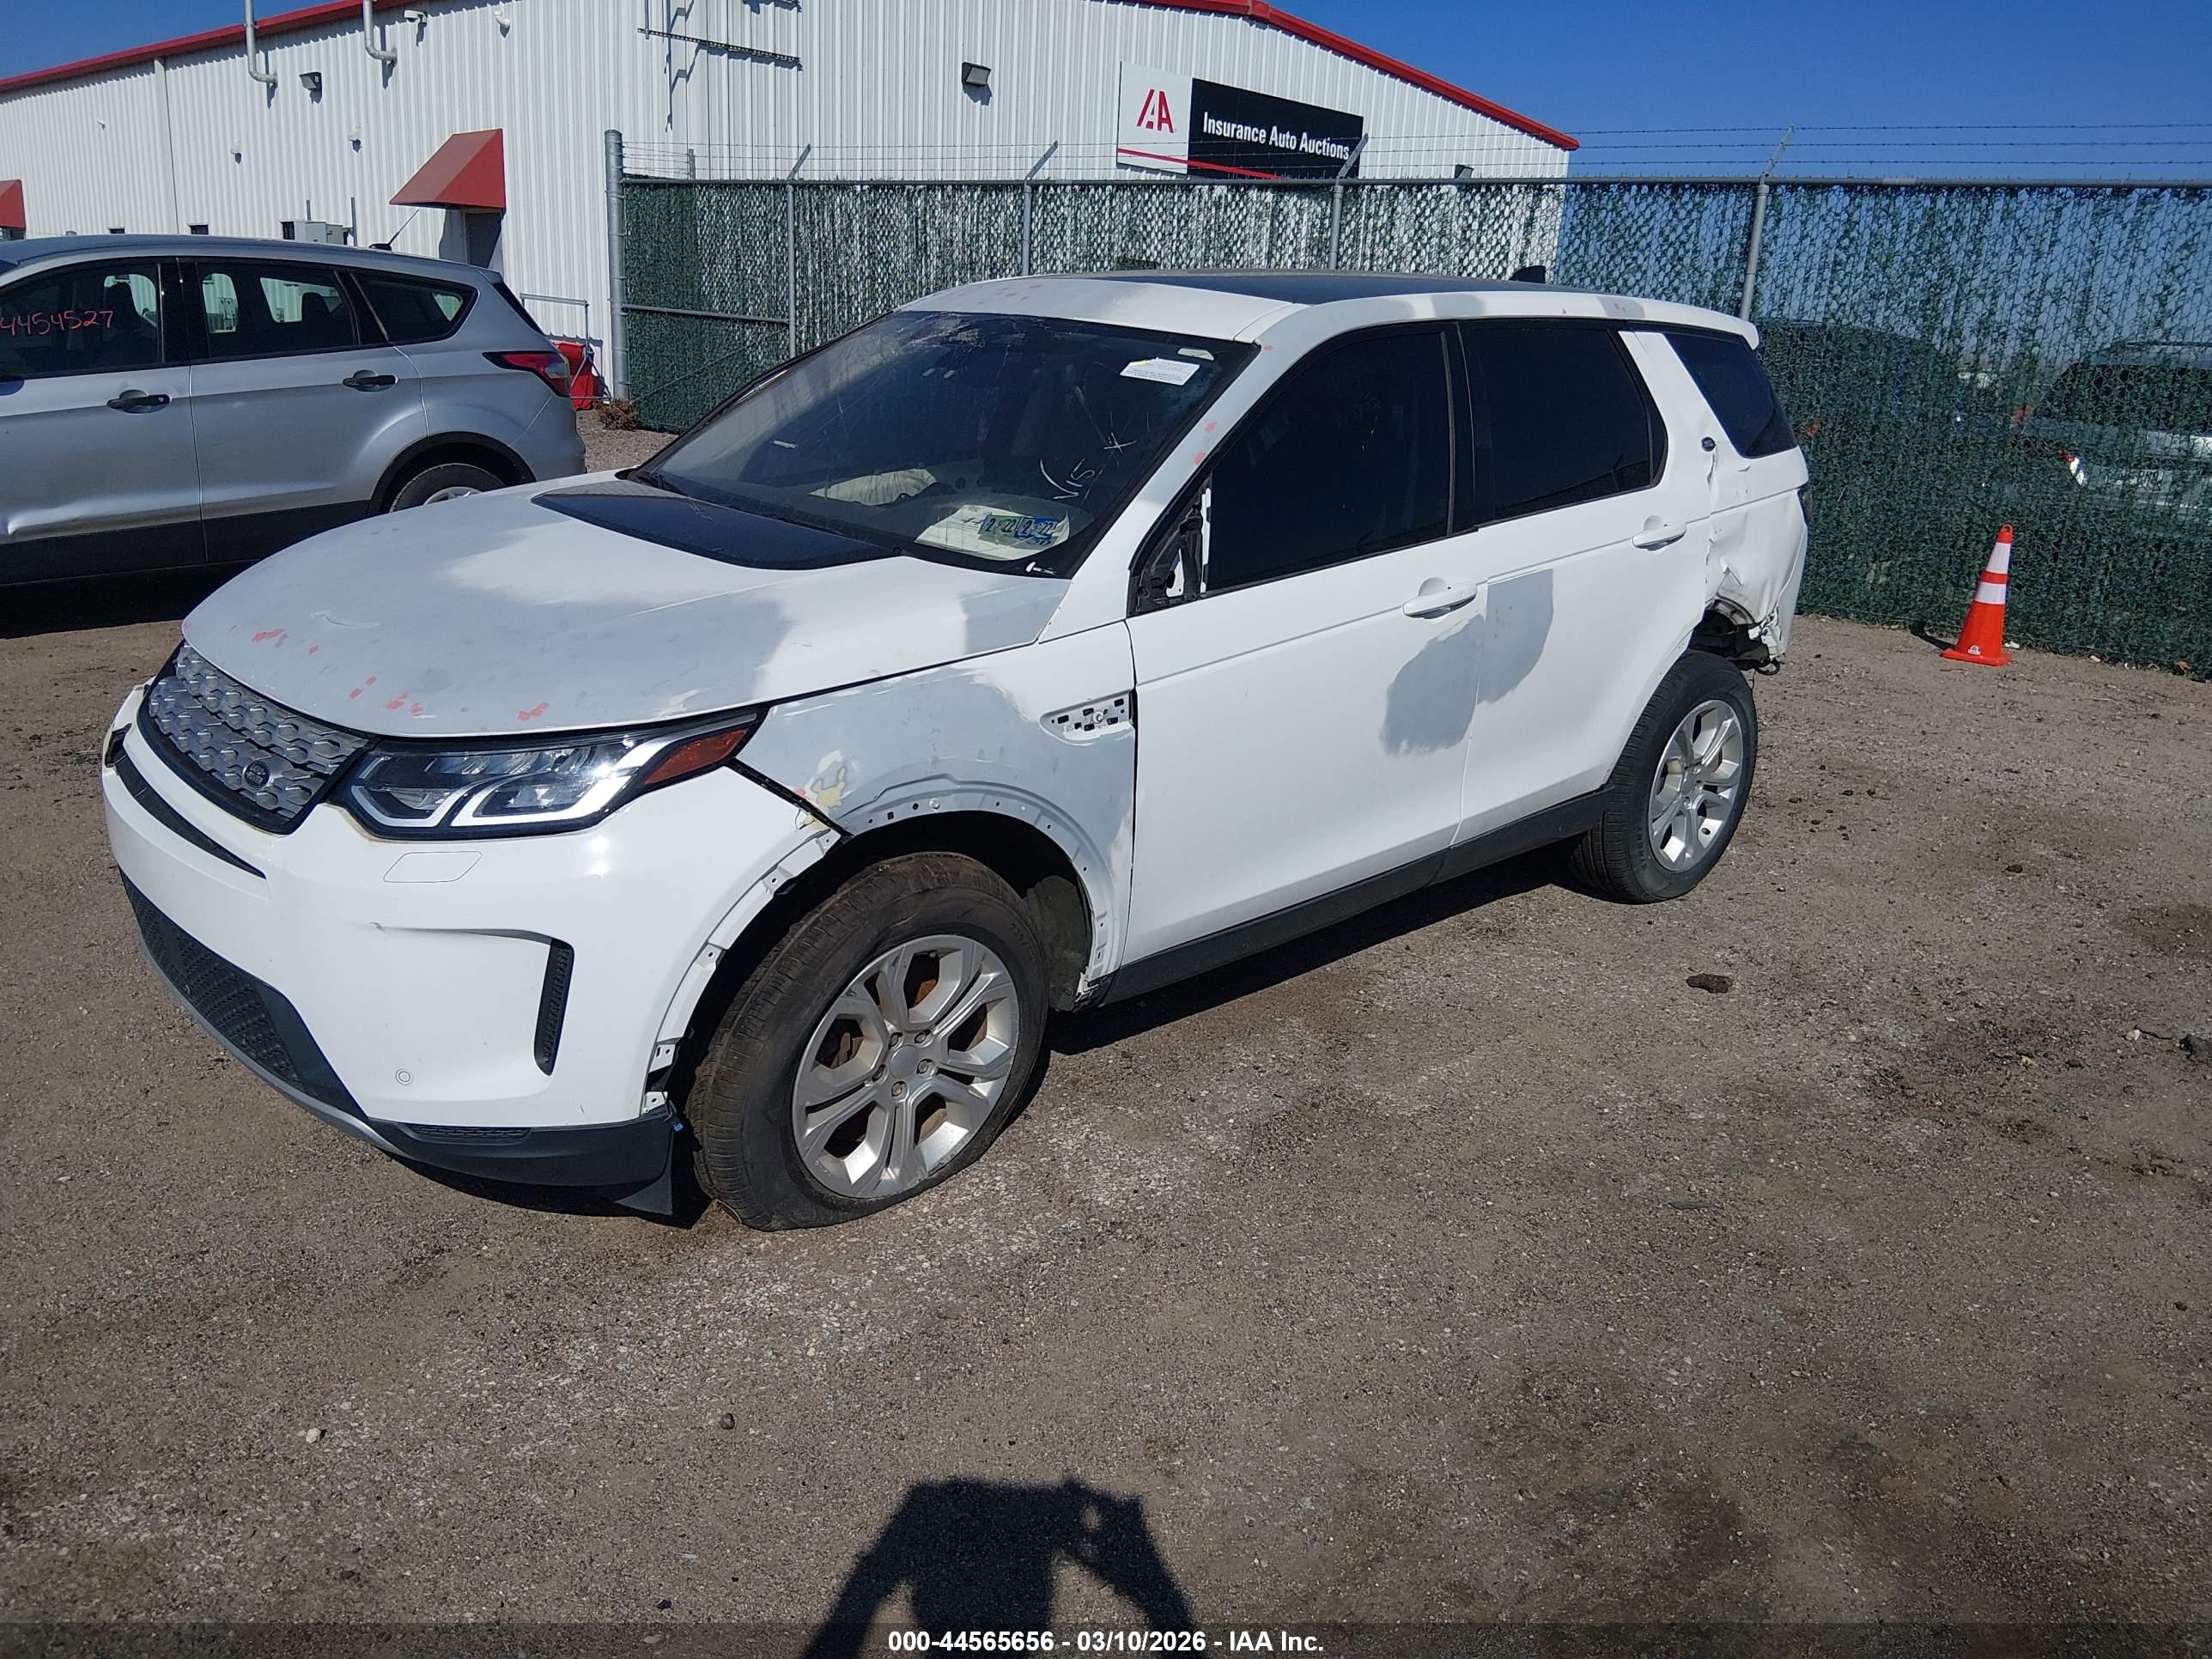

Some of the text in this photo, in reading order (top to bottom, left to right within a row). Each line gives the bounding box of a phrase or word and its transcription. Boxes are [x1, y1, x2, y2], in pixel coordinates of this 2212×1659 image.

[1203, 112, 1350, 161] Insurance Auto Auctions
